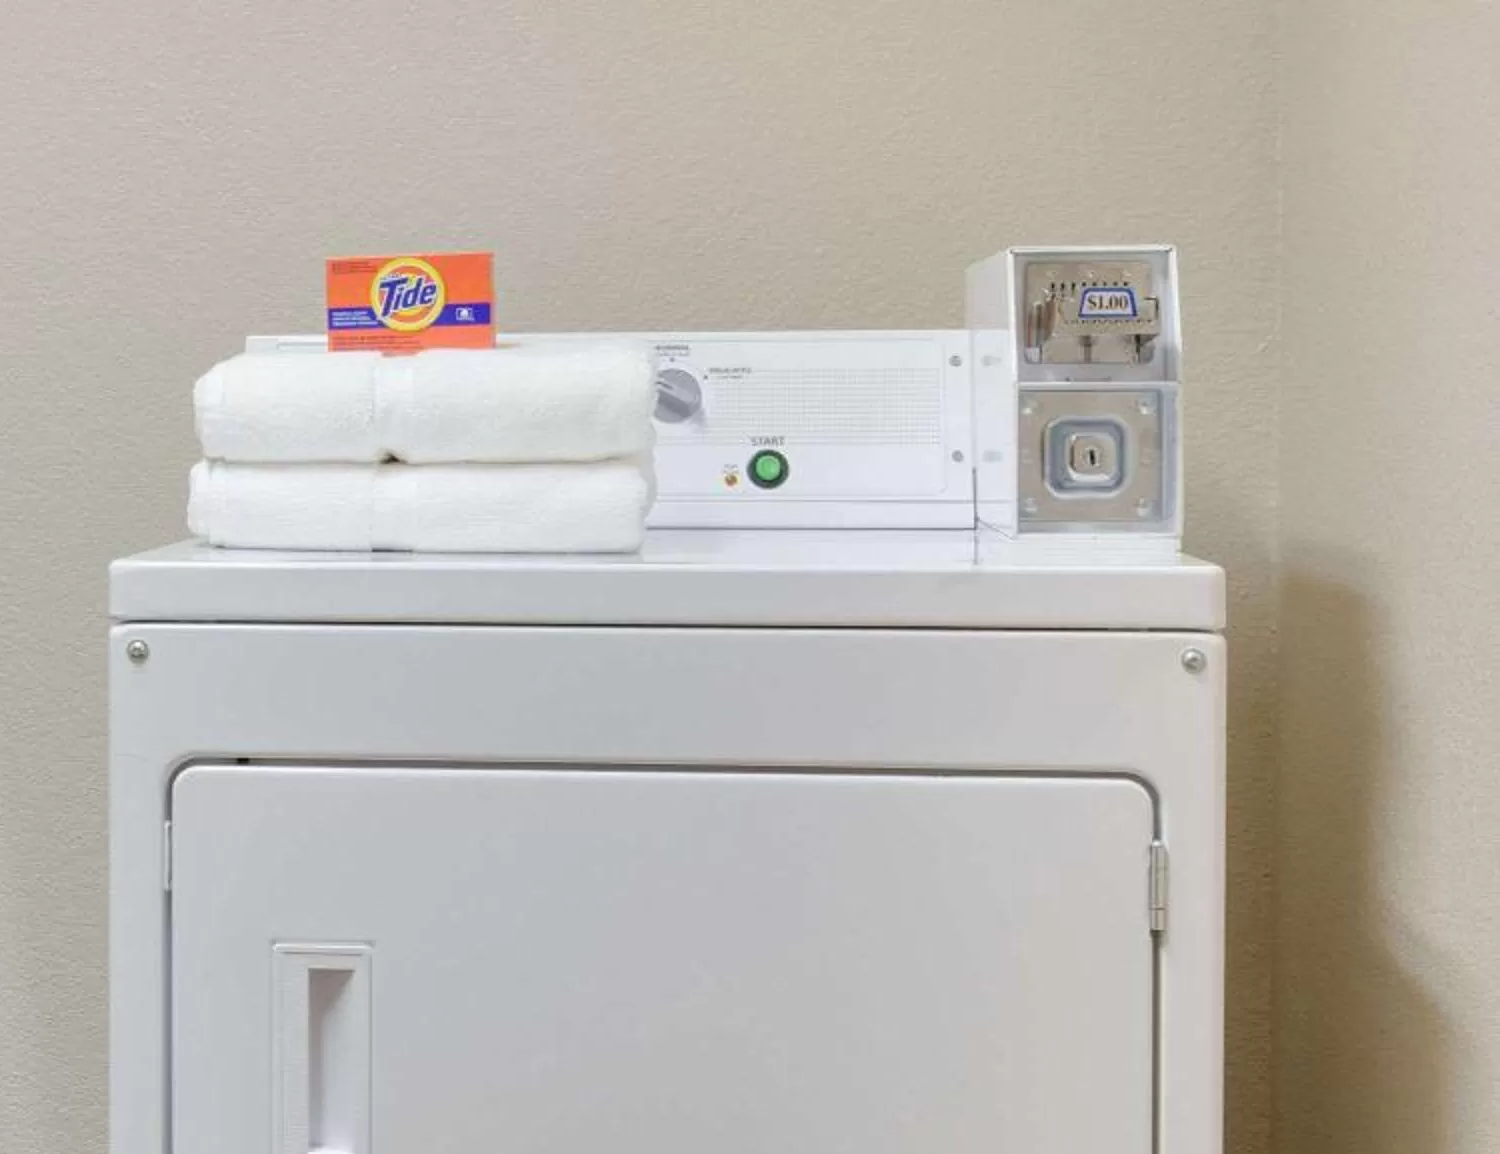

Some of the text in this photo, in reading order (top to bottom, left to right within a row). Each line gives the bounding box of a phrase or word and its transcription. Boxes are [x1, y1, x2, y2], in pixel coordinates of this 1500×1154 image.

[380, 277, 437, 317] Tide
[1087, 295, 1128, 310] $1.00
[751, 435, 785, 447] START
